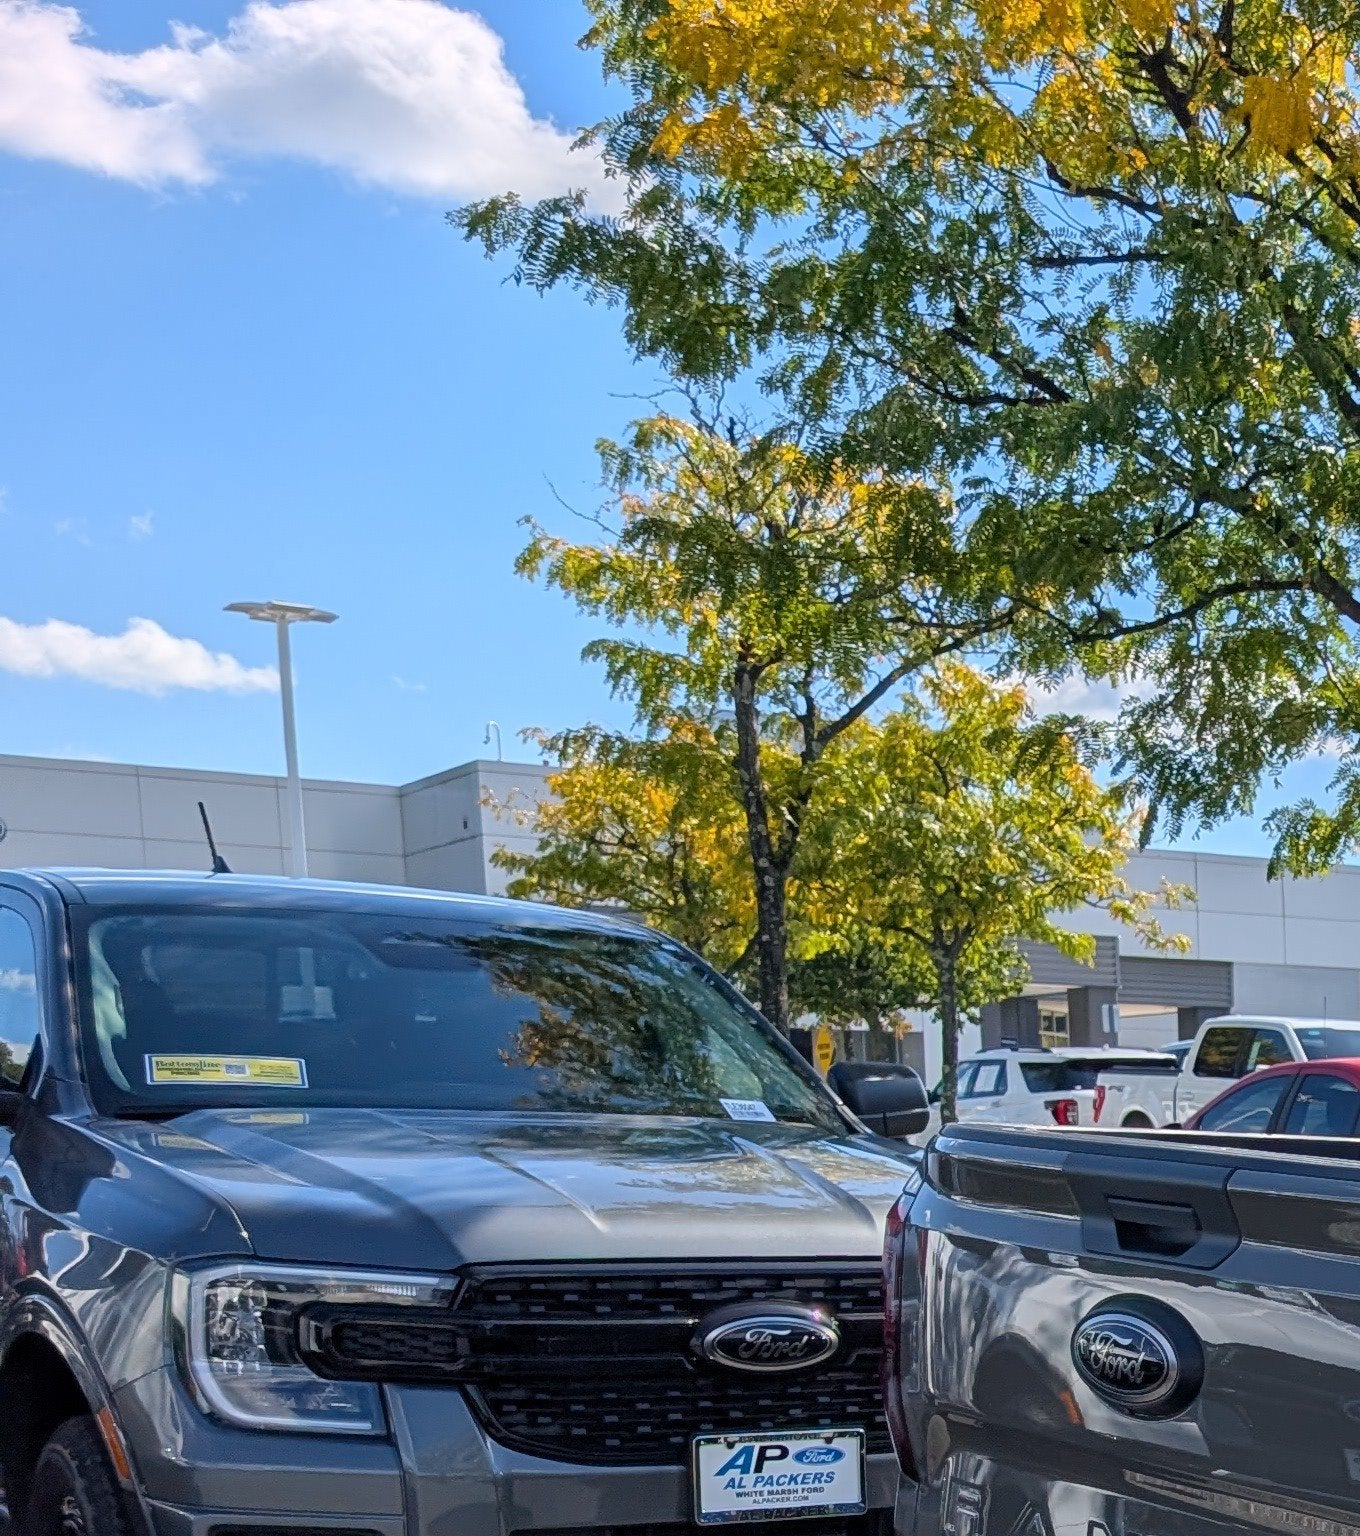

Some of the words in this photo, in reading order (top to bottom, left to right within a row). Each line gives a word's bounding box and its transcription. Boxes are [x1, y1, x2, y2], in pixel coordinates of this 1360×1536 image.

[738, 1328, 810, 1358] Ford
[1090, 1331, 1146, 1384] Ford
[713, 1444, 790, 1477] AP
[802, 1447, 836, 1463] Ford
[723, 1476, 747, 1491] AL
[752, 1470, 836, 1489] PACKERS
[735, 1489, 765, 1499] WHITE
[767, 1487, 800, 1497] MARSH
[801, 1485, 825, 1495] FORD
